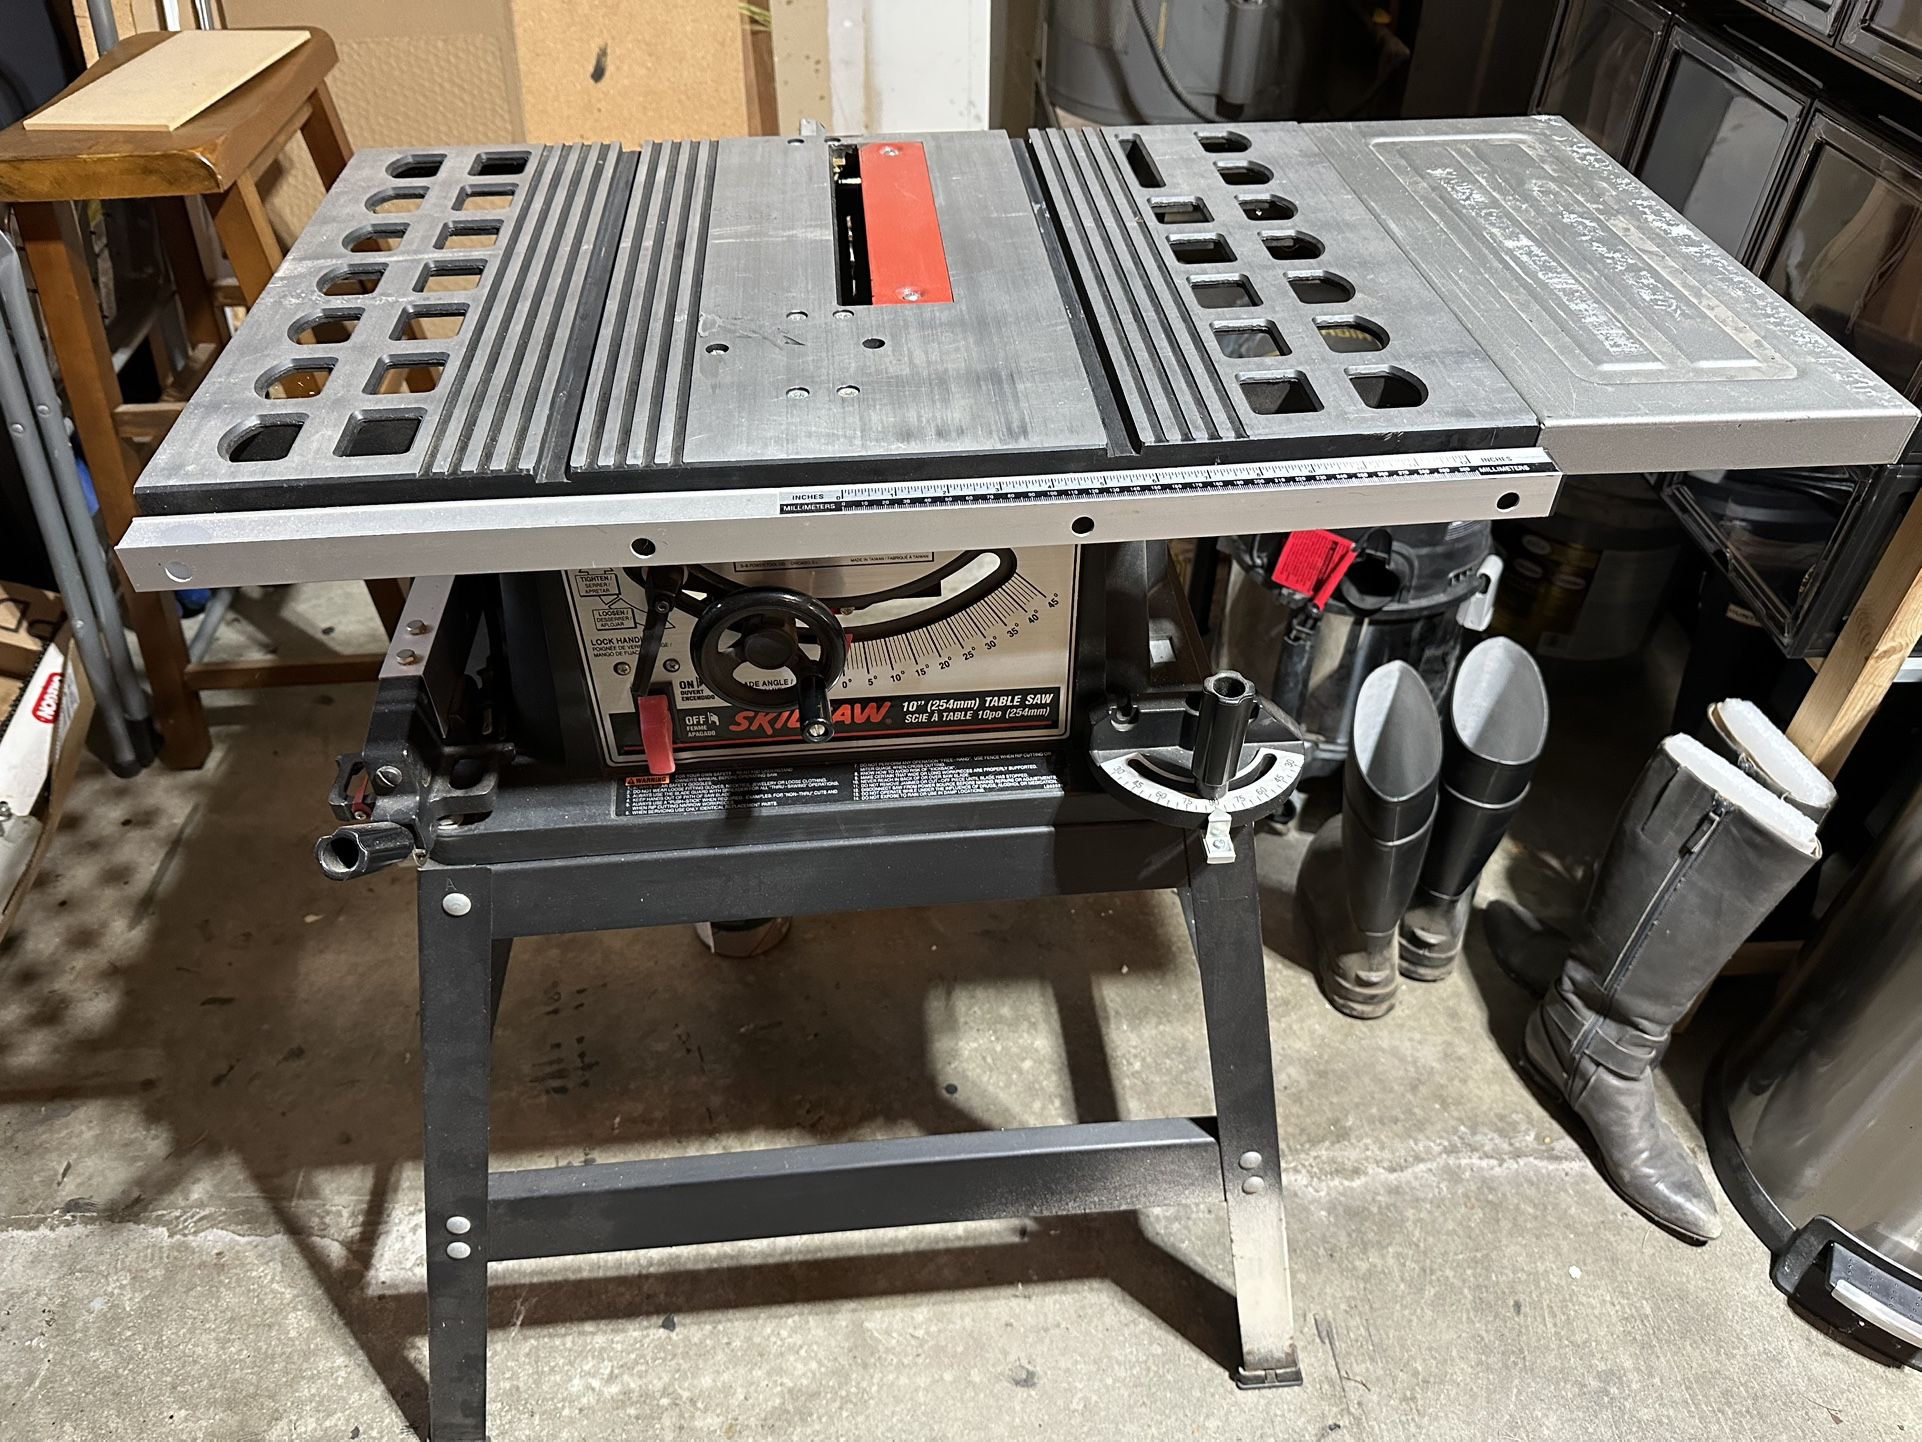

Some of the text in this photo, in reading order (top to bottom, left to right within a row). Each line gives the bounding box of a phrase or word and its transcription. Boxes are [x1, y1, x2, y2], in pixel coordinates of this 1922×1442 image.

[1479, 465, 1530, 473] MILLIMETERS
[580, 575, 609, 583] TIGHTEN
[1048, 592, 1059, 608] 45°
[598, 609, 626, 617] LOOSEN
[1027, 608, 1039, 624] 40°
[1006, 622, 1019, 638] 35°
[591, 636, 641, 646] LOCK HAND
[984, 635, 997, 651] 30°
[962, 646, 976, 661] 25°
[939, 655, 952, 670] 20°
[915, 663, 930, 677] 15°
[890, 670, 906, 682] 10°
[679, 680, 694, 690] ON
[762, 678, 789, 688] ANGLE
[680, 689, 705, 697] OUVERT
[681, 694, 716, 702] ENCENDIDO
[927, 697, 980, 713] (254mm)
[985, 695, 1022, 707] TABLE
[1025, 693, 1054, 705] SAW
[729, 701, 892, 736] SKILAW
[905, 706, 1050, 723] SCIE À TABLE 10po (254mm)
[685, 715, 706, 726] OFF
[687, 730, 716, 738] APAGADO
[635, 776, 667, 784] WARNING
